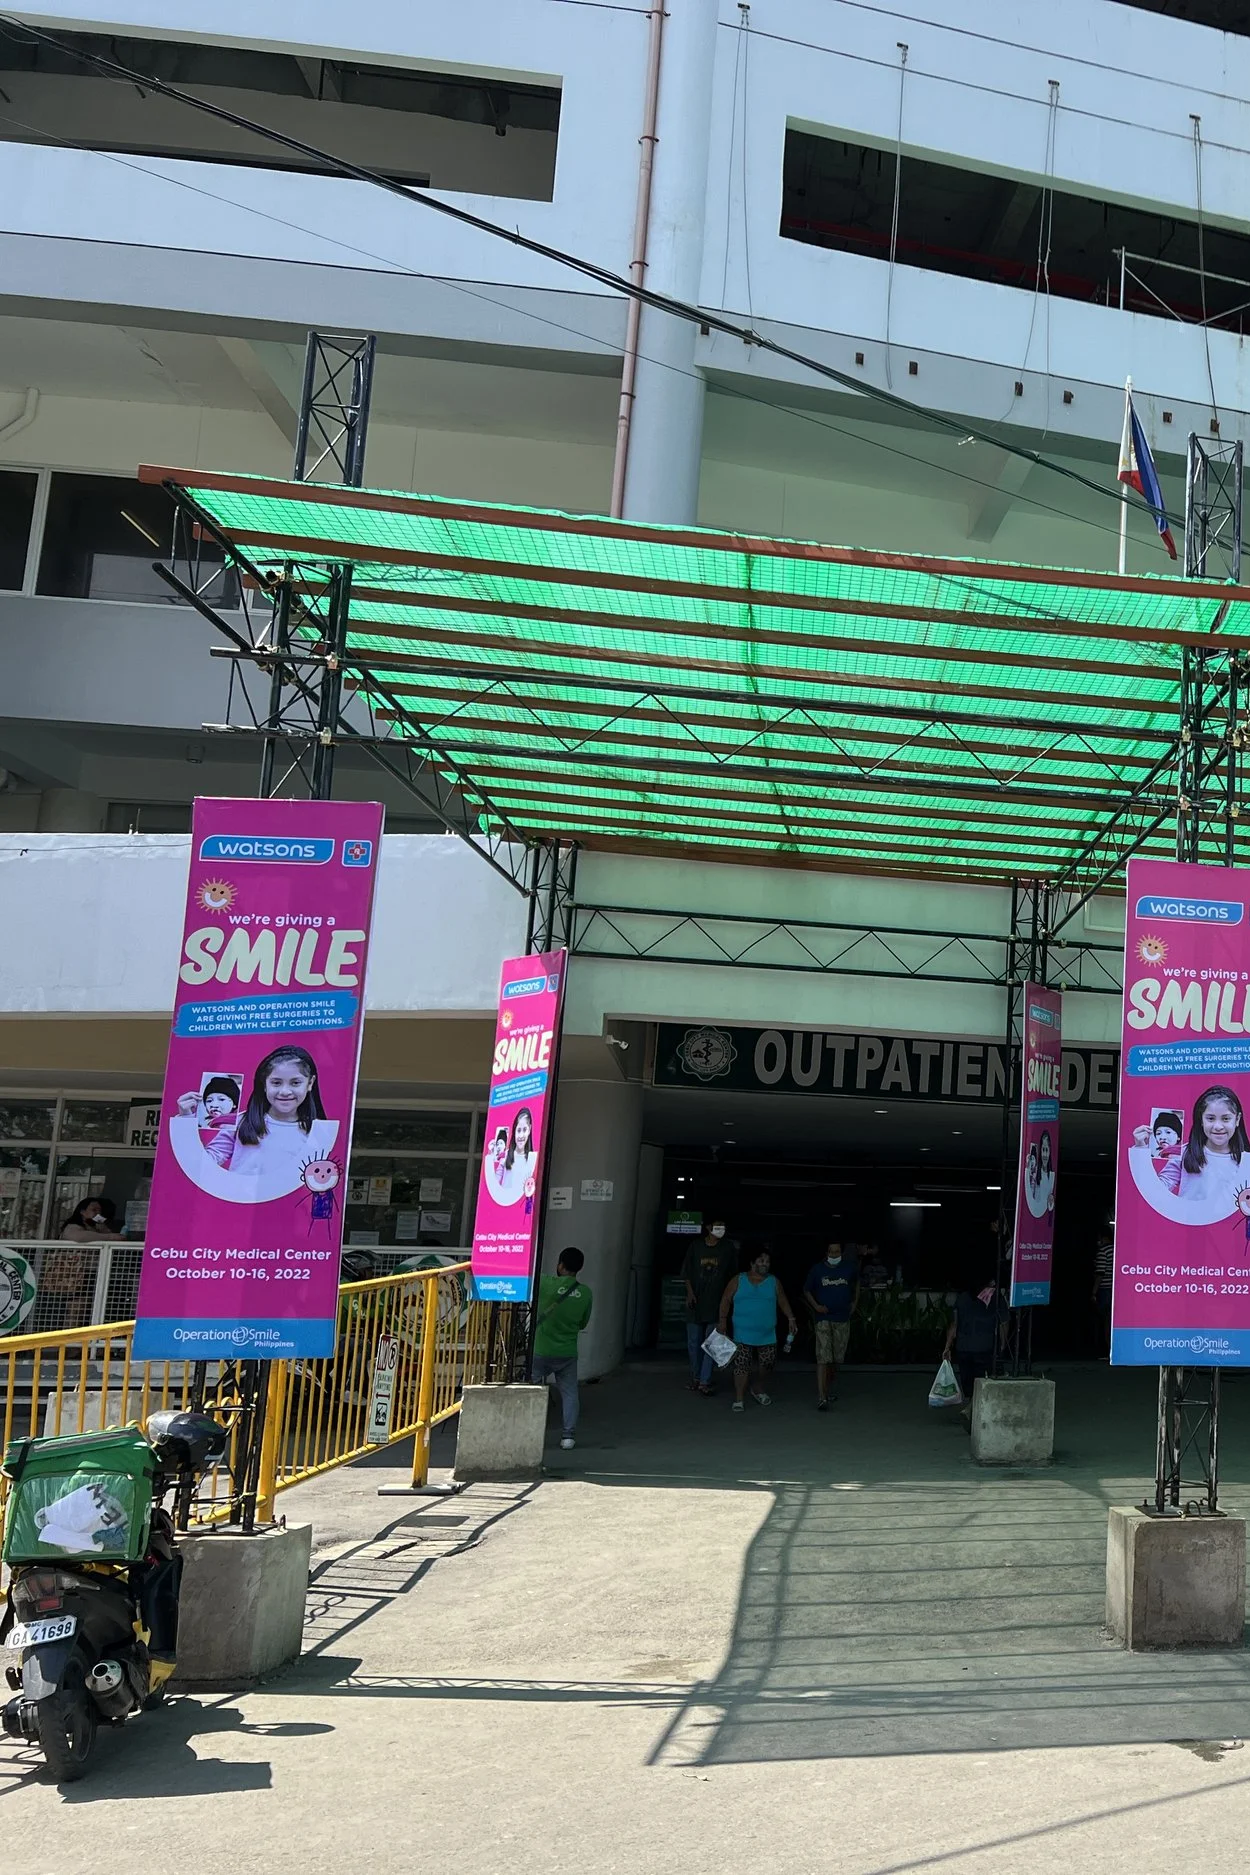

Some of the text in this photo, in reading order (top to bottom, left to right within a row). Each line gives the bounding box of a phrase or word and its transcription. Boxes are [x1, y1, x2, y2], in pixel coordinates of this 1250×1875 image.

[218, 841, 315, 858] watsons
[1150, 902, 1228, 919] watsons
[229, 914, 335, 927] we're giving a
[179, 926, 366, 988] SMILE
[1163, 967, 1248, 981] we're giving a
[508, 981, 540, 994] watsons
[192, 1005, 235, 1014] WATSONS
[259, 1001, 308, 1010] OPERATION
[311, 1000, 335, 1008] SMILE
[197, 1014, 215, 1022] ARE
[217, 1013, 247, 1021] GIVING
[250, 1012, 271, 1020] FREE
[273, 1009, 320, 1019] SURGERIES
[189, 1023, 233, 1032] CHILDREN
[260, 1020, 286, 1028] CLEFT
[289, 1018, 344, 1027] CONDITIONS.
[492, 1030, 553, 1076] SMILE
[1139, 1047, 1174, 1055] WATSONS
[1192, 1046, 1231, 1054] OPERATION
[754, 1030, 1022, 1099] OUTPATIEN
[1137, 1064, 1172, 1072] CHILDREN
[1028, 1058, 1060, 1098] SMILE
[150, 1247, 331, 1262] Cebu City Medical Center
[166, 1268, 311, 1281] October 10-16, 2022
[1121, 1265, 1150, 1275] Cebu
[1154, 1265, 1177, 1277] City
[1180, 1266, 1224, 1276] Medical
[557, 1286, 582, 1298] Gab
[1134, 1283, 1249, 1295] October 10-16, 2022
[173, 1328, 280, 1343] Operation Smile
[254, 1340, 294, 1348] Philippines
[1144, 1337, 1229, 1349] Operation Smile
[31, 1621, 72, 1641] 41698
